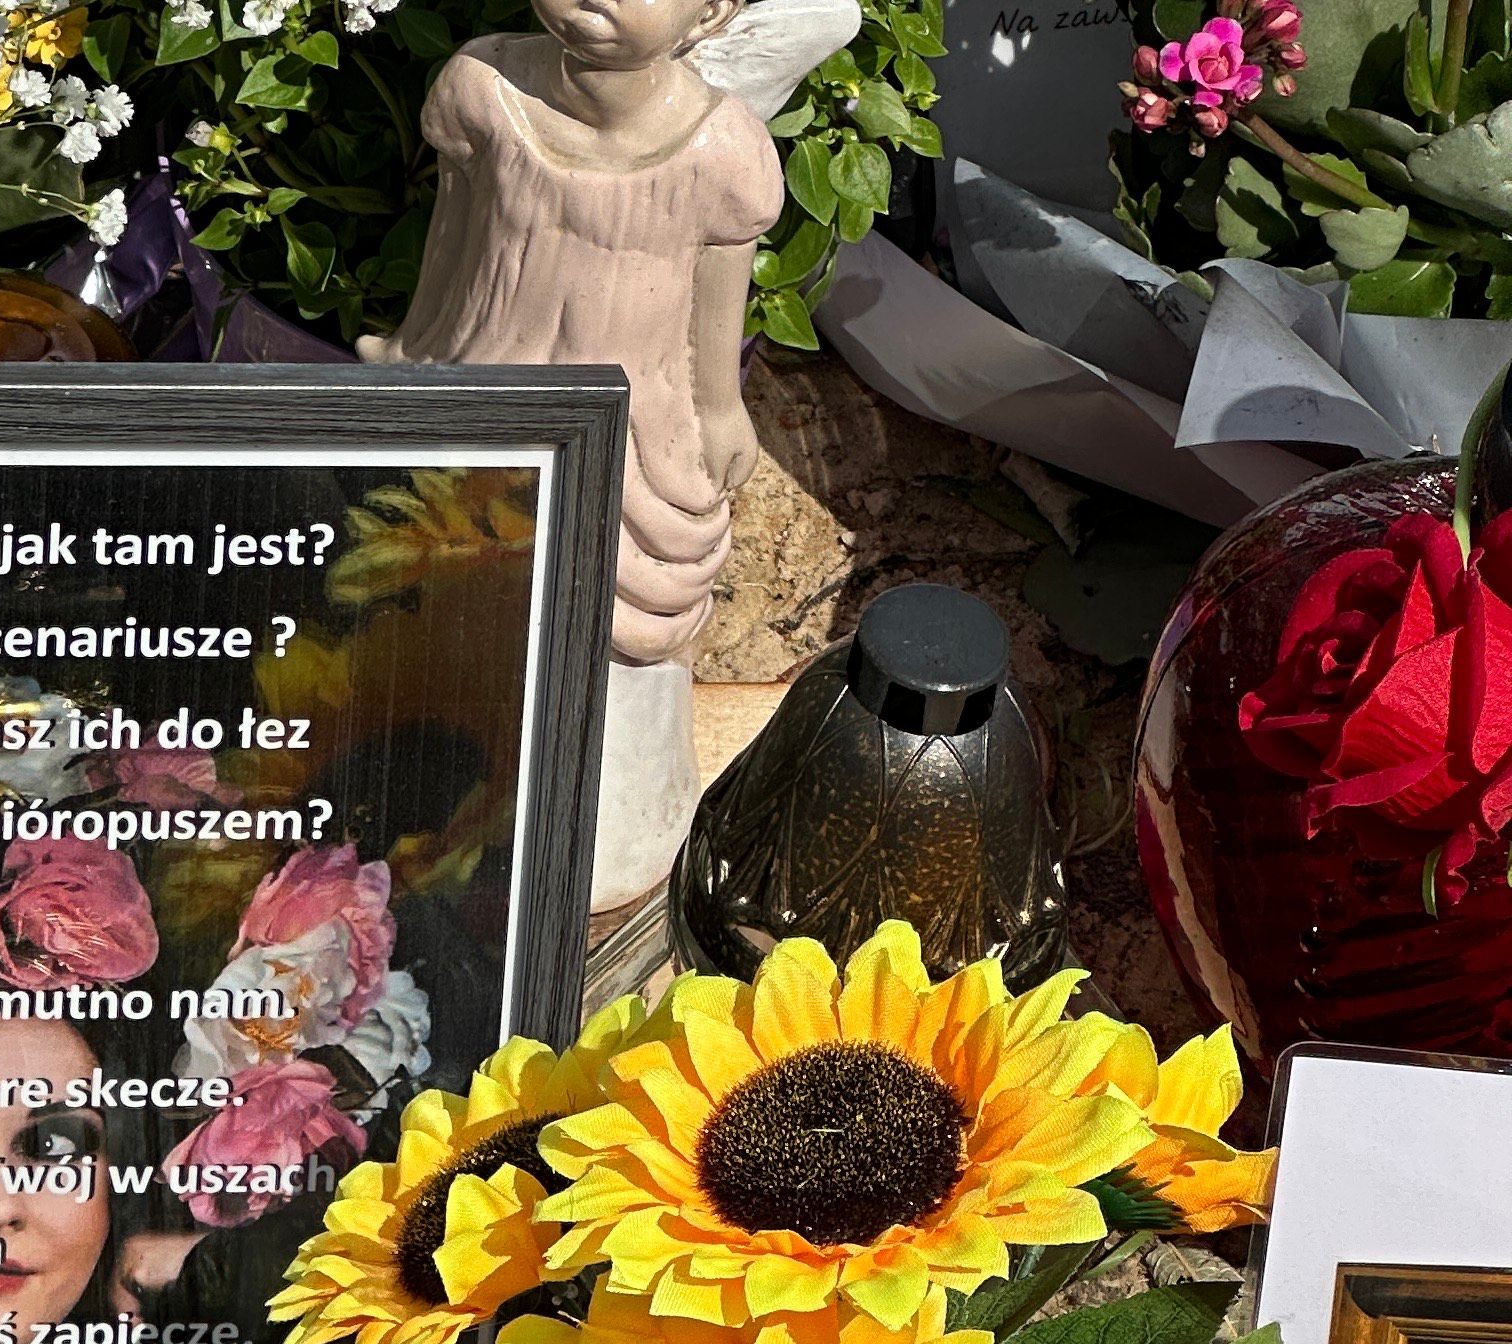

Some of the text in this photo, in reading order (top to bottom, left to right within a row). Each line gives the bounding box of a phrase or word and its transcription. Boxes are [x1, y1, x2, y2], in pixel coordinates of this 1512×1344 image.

[990, 8, 1039, 36] Na
[93, 531, 196, 567] tam
[207, 522, 336, 574] jest?
[271, 616, 297, 658] ?
[69, 707, 142, 749] ich
[157, 709, 226, 750] do
[238, 708, 311, 750] łez
[169, 988, 298, 1023] nam.
[64, 1069, 247, 1111] skecze.
[109, 1166, 153, 1196] w
[168, 1155, 337, 1199] uszach
